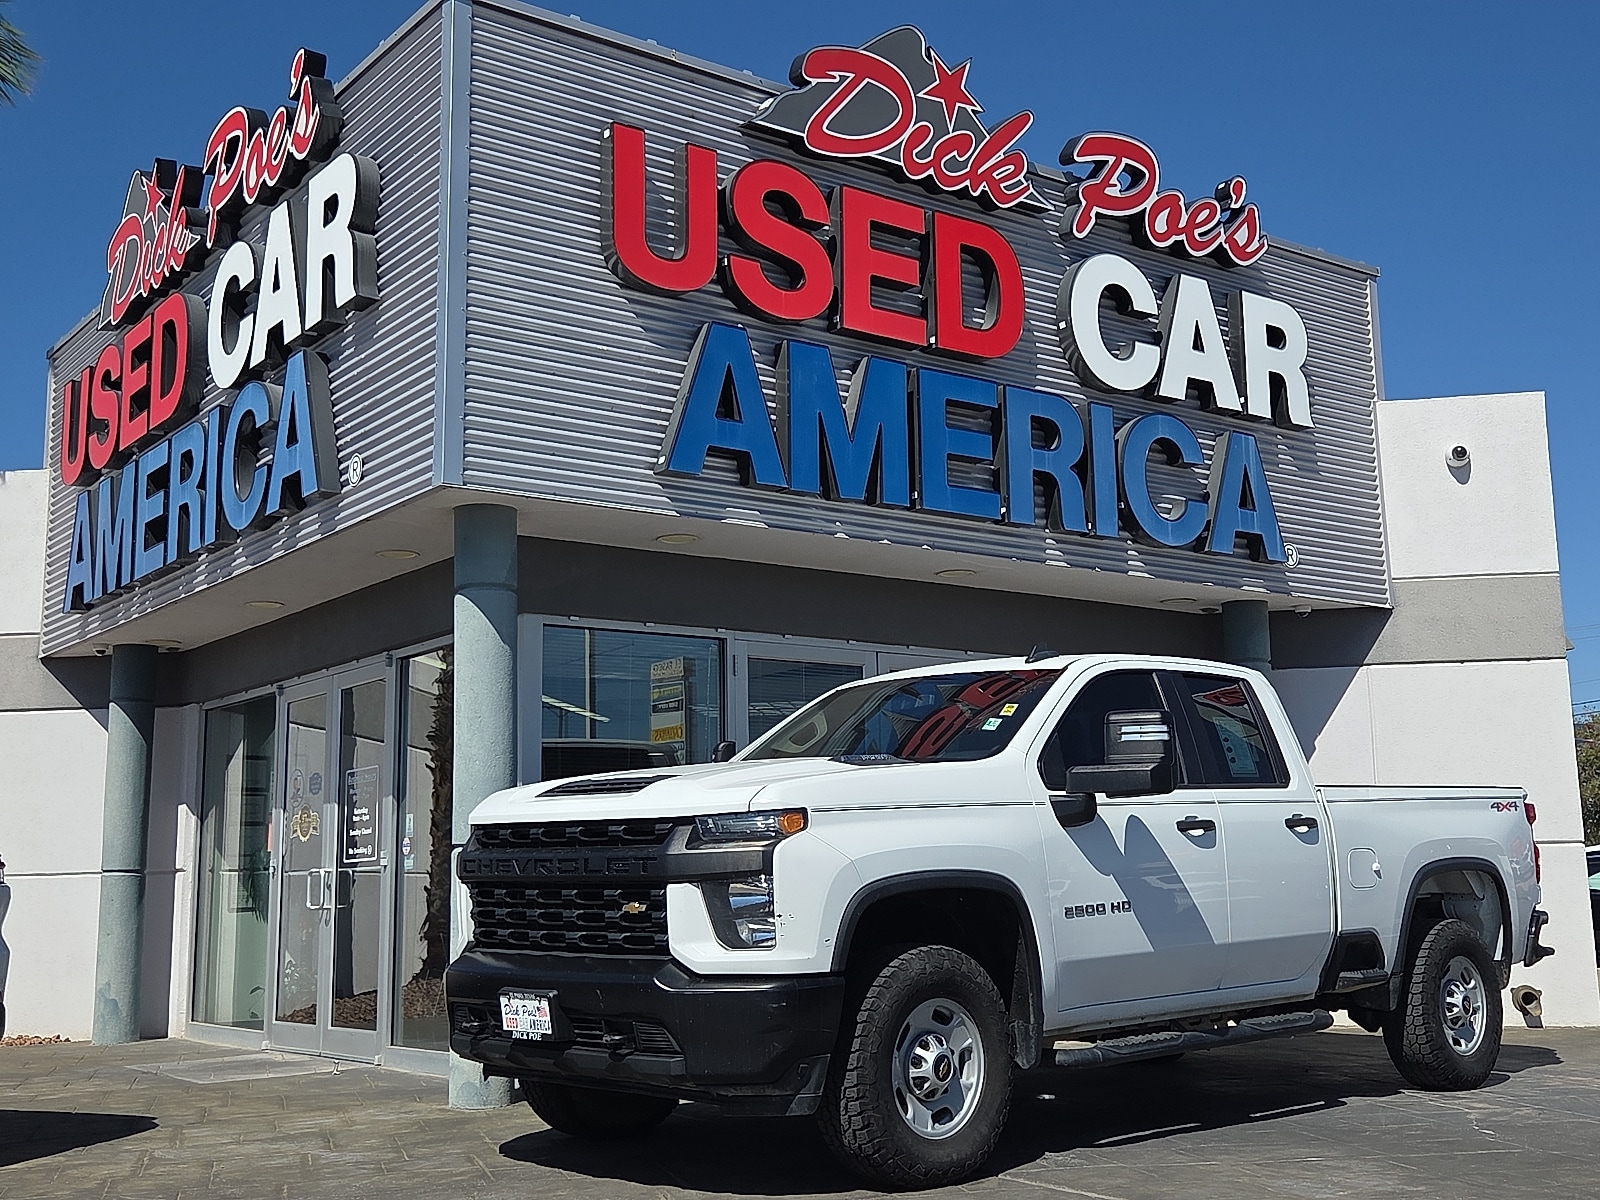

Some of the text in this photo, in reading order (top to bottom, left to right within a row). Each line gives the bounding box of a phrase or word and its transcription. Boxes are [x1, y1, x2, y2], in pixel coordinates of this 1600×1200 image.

[107, 48, 320, 325] Dick Poe's
[610, 121, 1314, 429] USED CAR
[800, 46, 1268, 267] Dick Poe's
[61, 153, 357, 486] USED CAR
[63, 349, 318, 613] AMERICA
[666, 322, 1288, 564] AMERICA
[463, 855, 658, 876] CHEVROLET
[1064, 900, 1133, 919] 2500 HD
[513, 1031, 542, 1041] DICK POE
